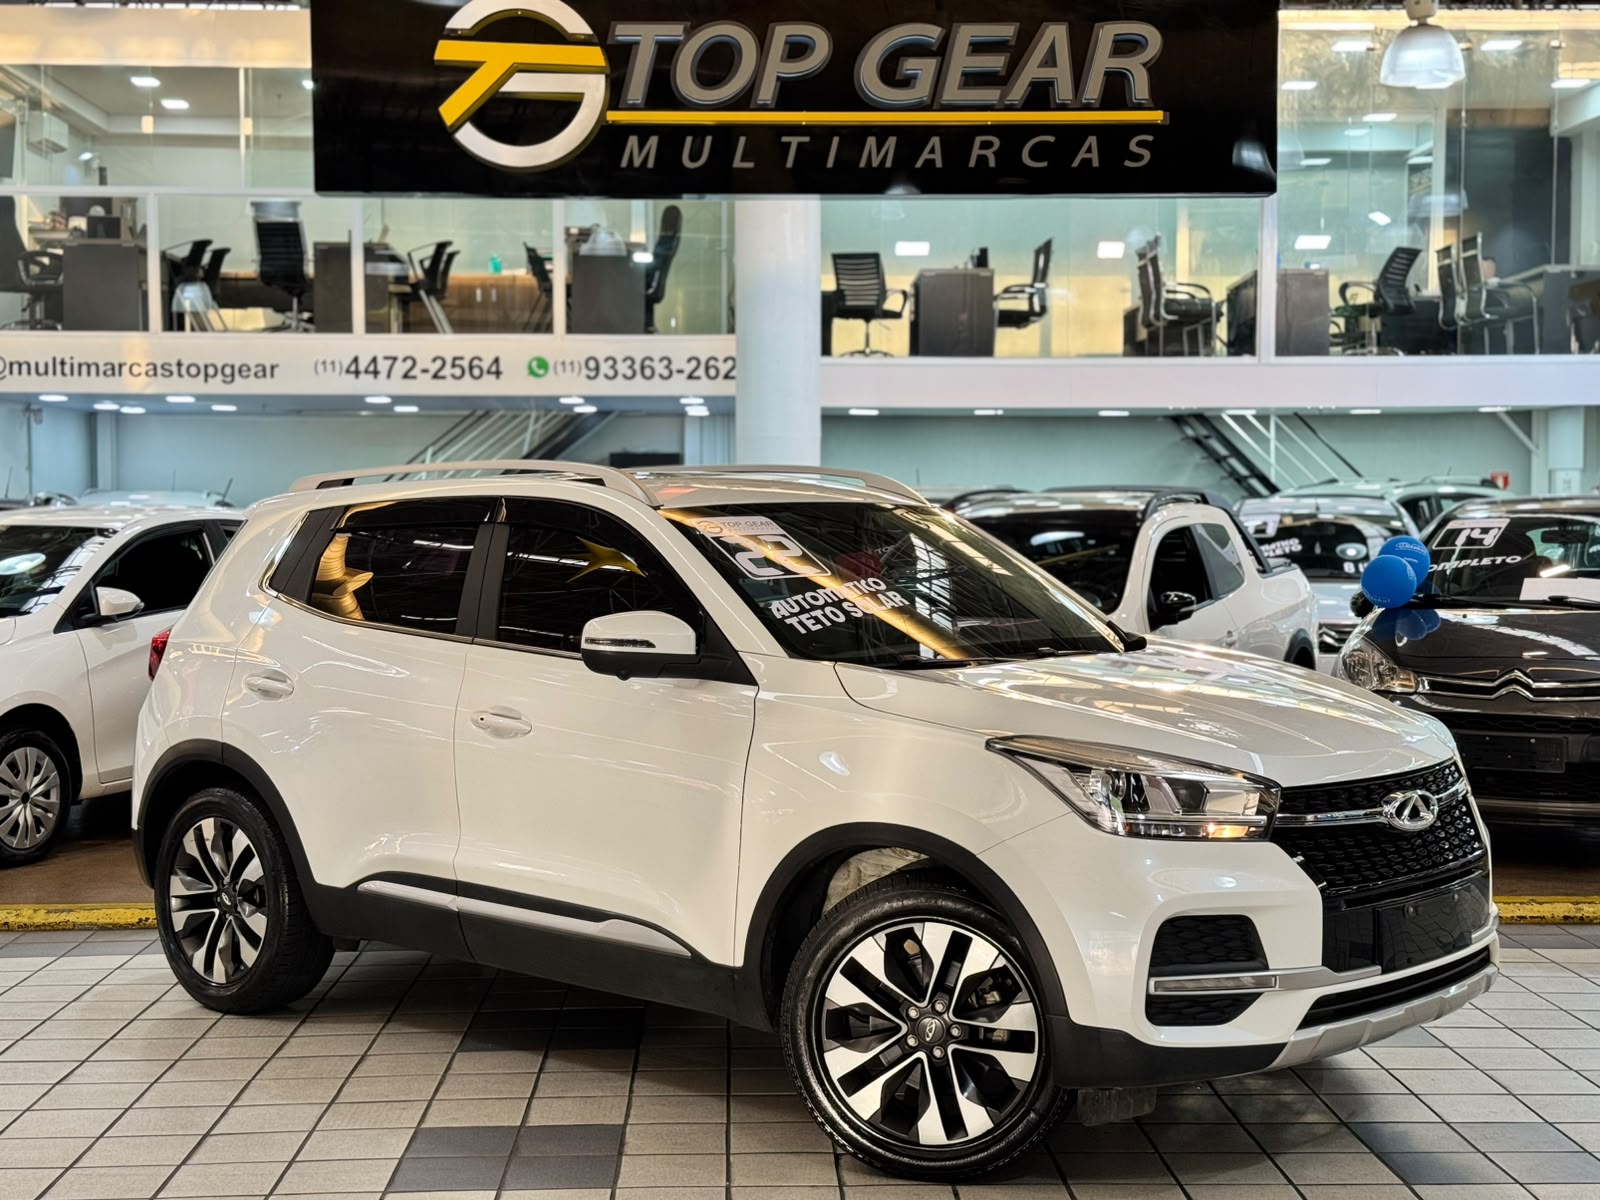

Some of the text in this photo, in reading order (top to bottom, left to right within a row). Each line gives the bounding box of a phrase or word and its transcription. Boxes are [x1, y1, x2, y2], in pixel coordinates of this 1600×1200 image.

[609, 20, 1164, 107] TOP GEAR
[619, 134, 1154, 169] MULTIMARCAS
[0, 355, 279, 384] multimarcastopgear
[1455, 527, 1499, 546] 14
[1428, 555, 1522, 573] OMPLETO
[784, 591, 910, 634] TETO SOLAR
